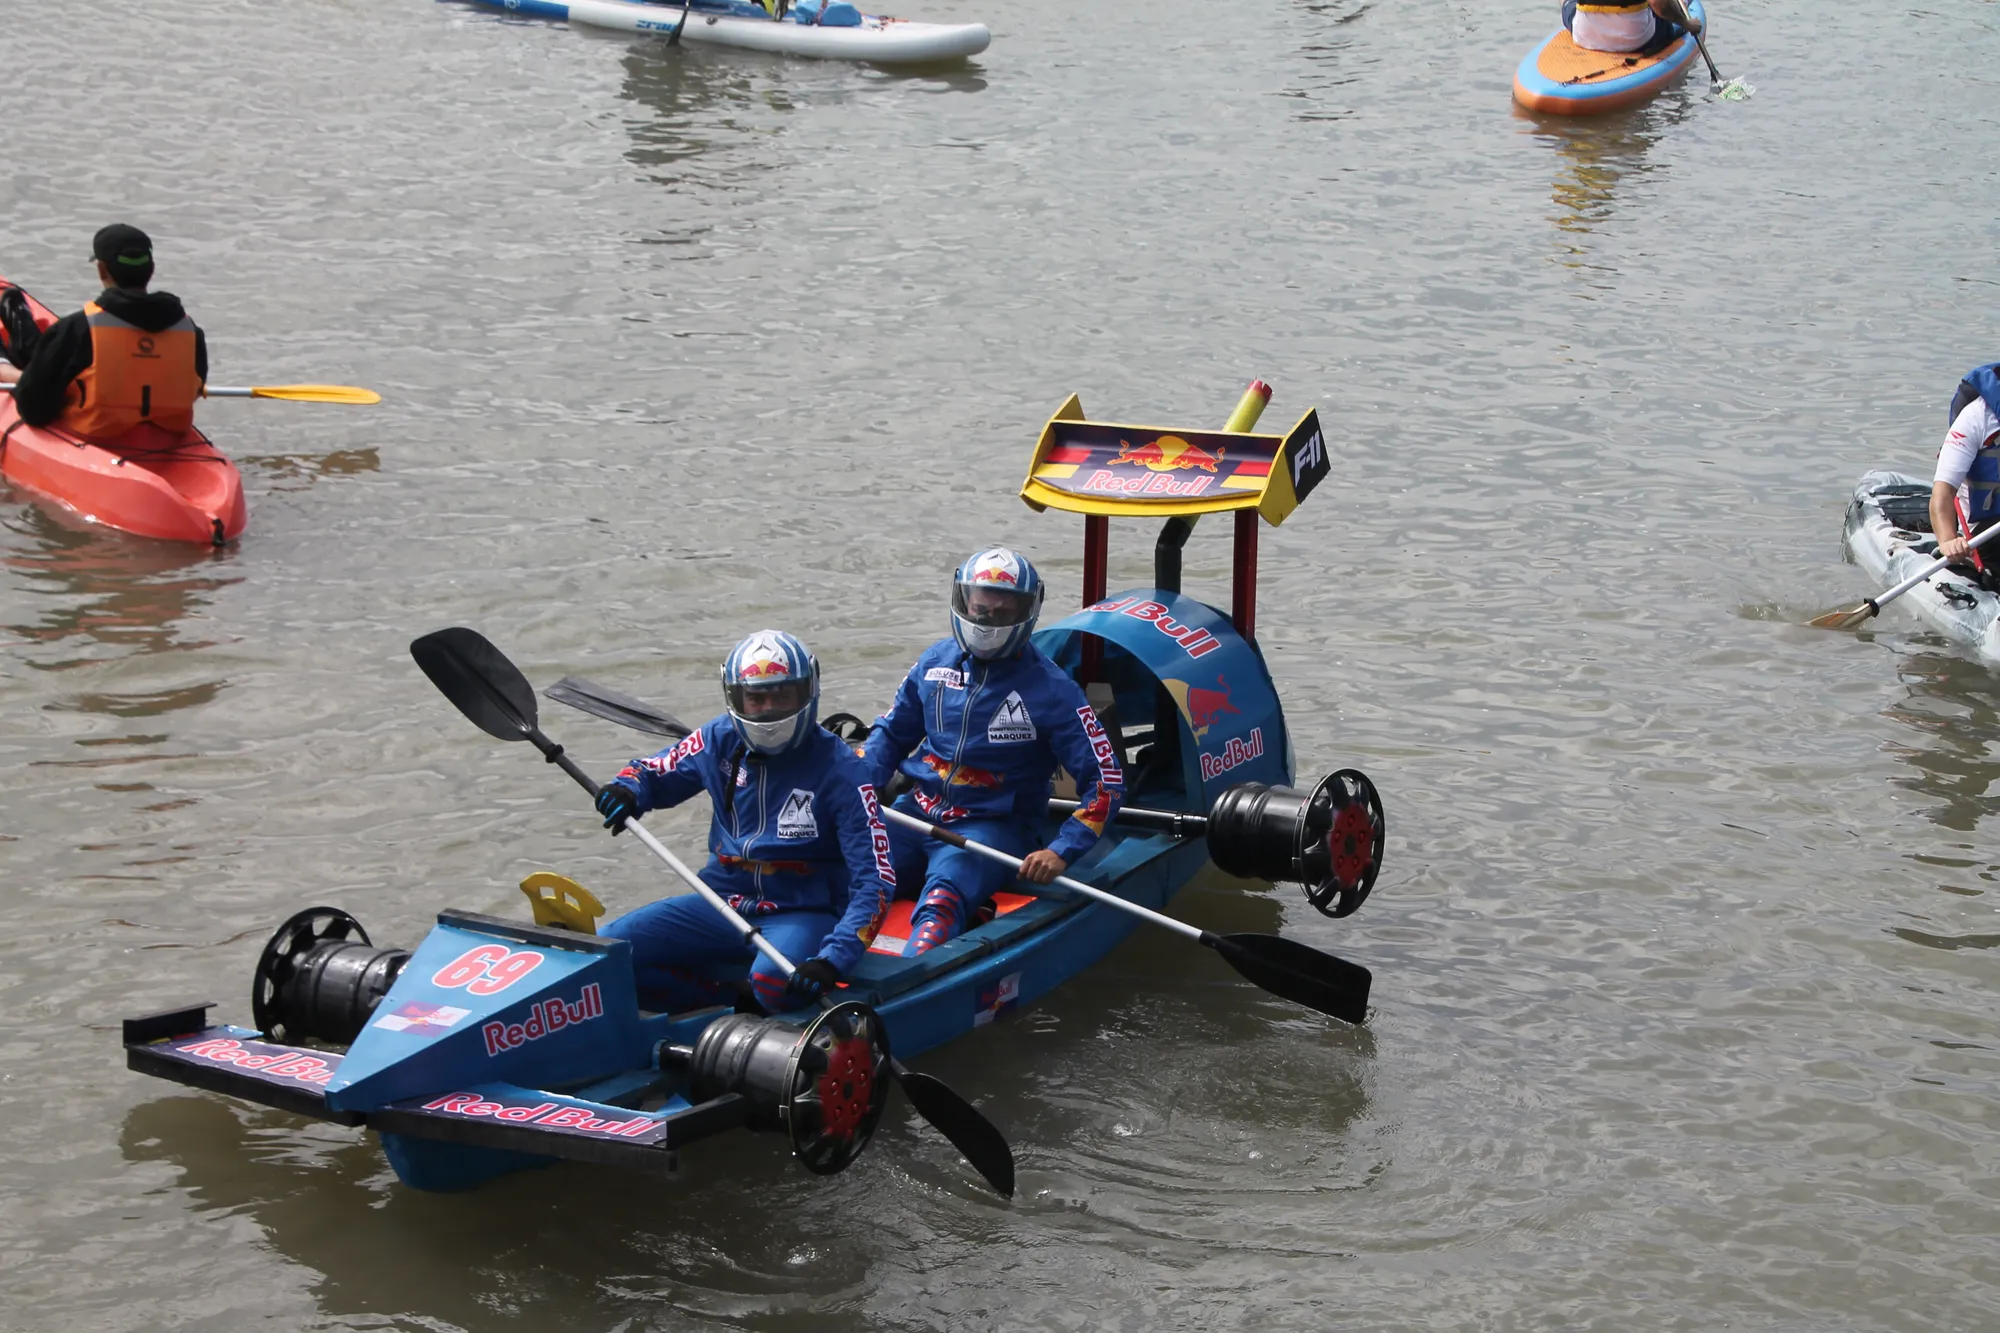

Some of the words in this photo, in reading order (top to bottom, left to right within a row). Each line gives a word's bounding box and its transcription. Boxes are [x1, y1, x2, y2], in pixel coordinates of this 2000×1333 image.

[990, 733, 1032, 741] MARQUEZ
[779, 829, 817, 838] MARQUEZ
[431, 944, 545, 996] 69
